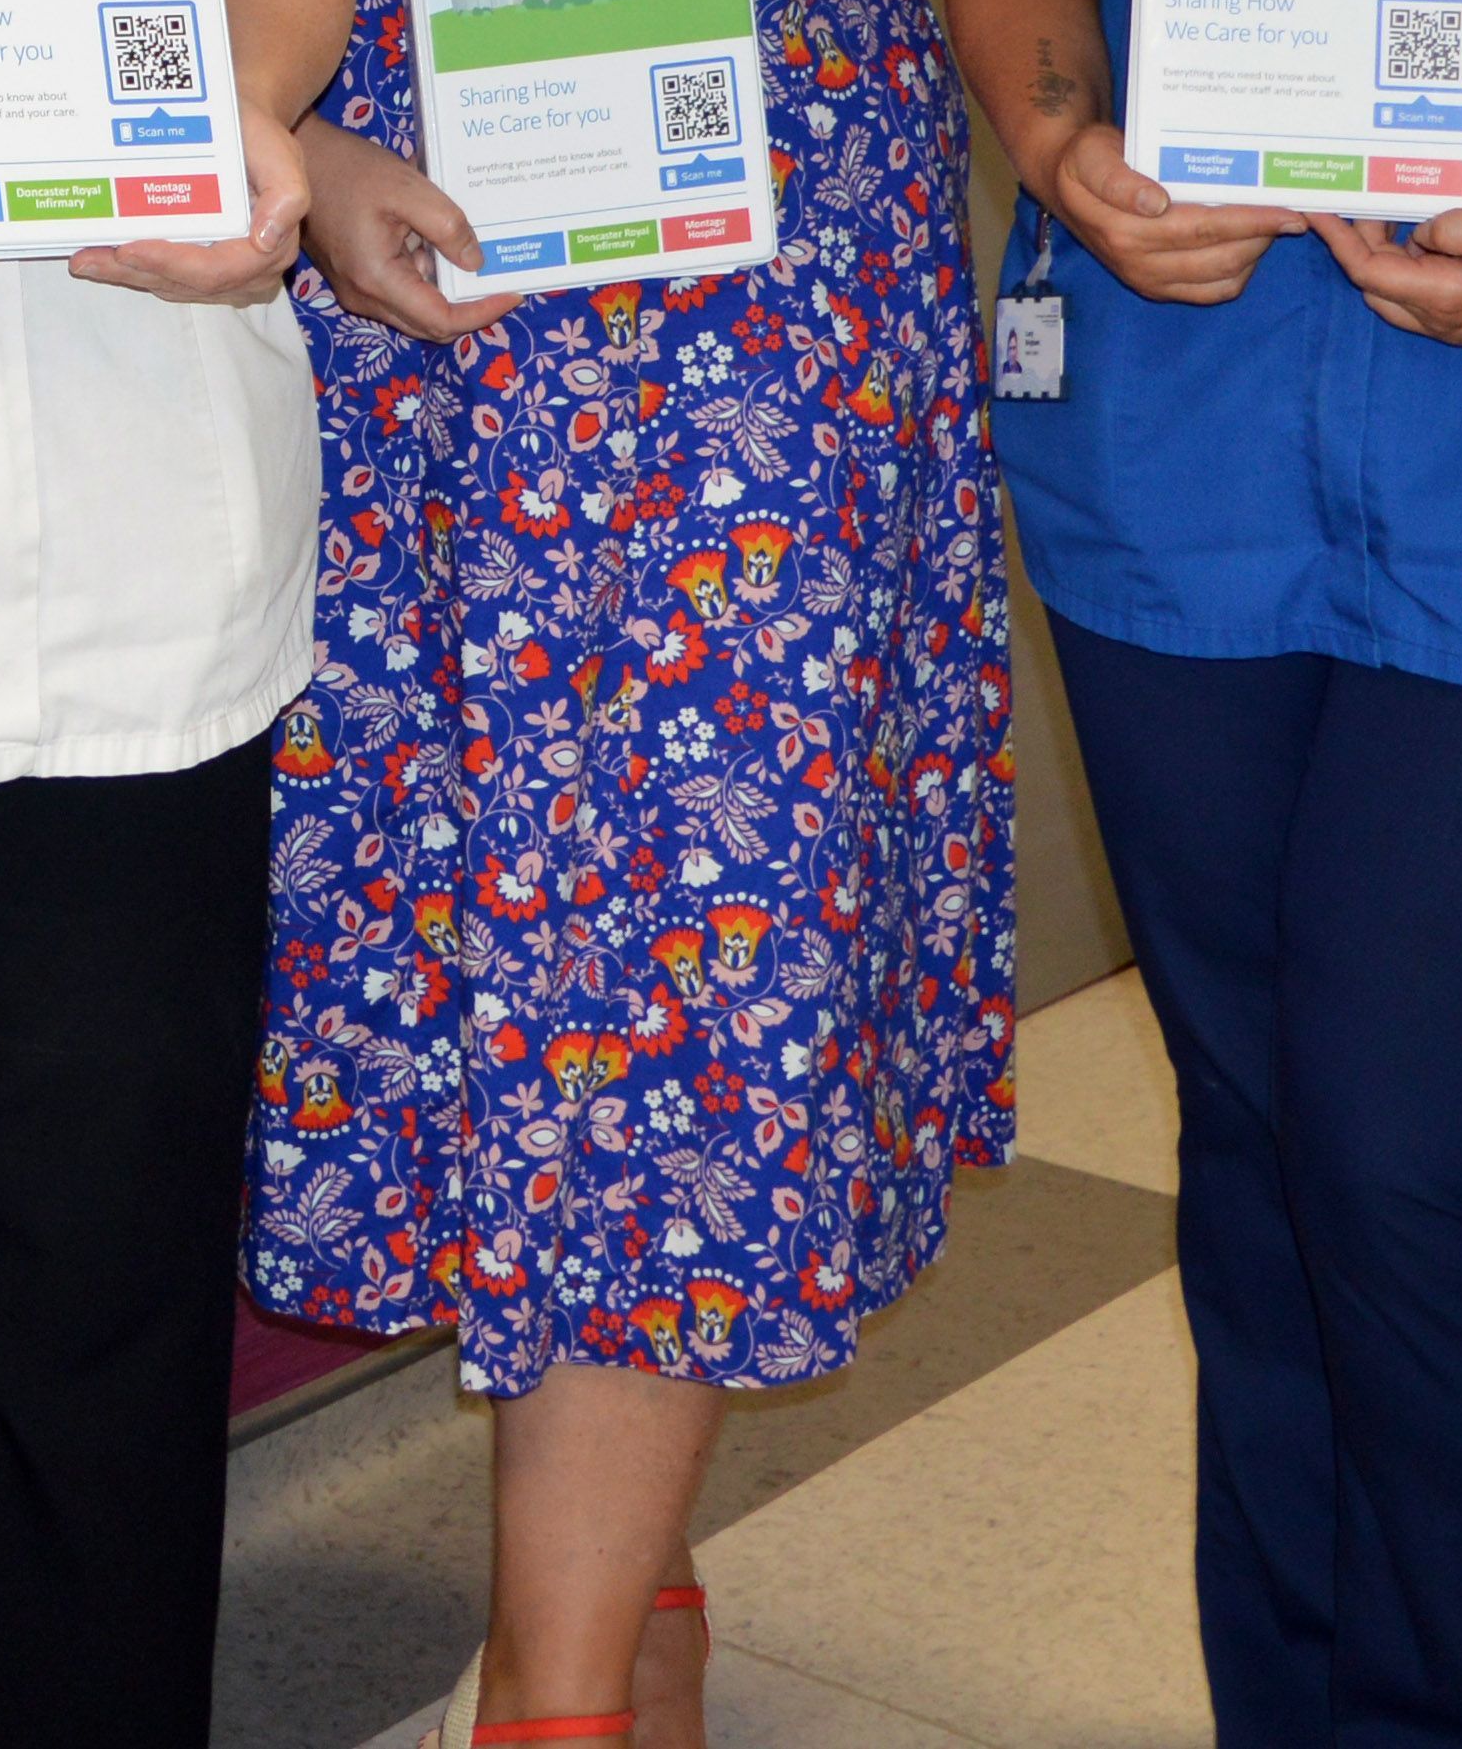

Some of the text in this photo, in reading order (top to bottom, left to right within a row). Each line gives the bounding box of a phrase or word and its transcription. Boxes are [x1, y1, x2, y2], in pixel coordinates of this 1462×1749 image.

[1165, 20, 1327, 49] We Care for you
[12, 44, 53, 66] you
[458, 79, 576, 108] Sharing How
[461, 107, 611, 138] We Care for you
[1397, 111, 1444, 123] Scan me
[137, 126, 185, 137] Scan me
[1183, 153, 1233, 165] Bassetlaw
[1272, 157, 1354, 172] Doncaster Royal
[681, 169, 722, 182] Scan me
[1187, 164, 1228, 176] Hospital
[1289, 168, 1336, 181] Infirmary
[1394, 162, 1442, 176] Montagu
[1396, 173, 1439, 185] Hospital
[16, 184, 101, 198] Doncaster Royal
[143, 182, 191, 194] Montagu
[35, 198, 85, 209] Infirmary
[146, 193, 190, 205] Hospital
[684, 217, 726, 229] Montagu
[576, 225, 649, 244] Doncaster Royal
[687, 226, 725, 239] Hospital
[495, 241, 541, 254] Bassetlaw
[593, 239, 635, 251] Infirmary
[500, 250, 539, 264] Hospital
